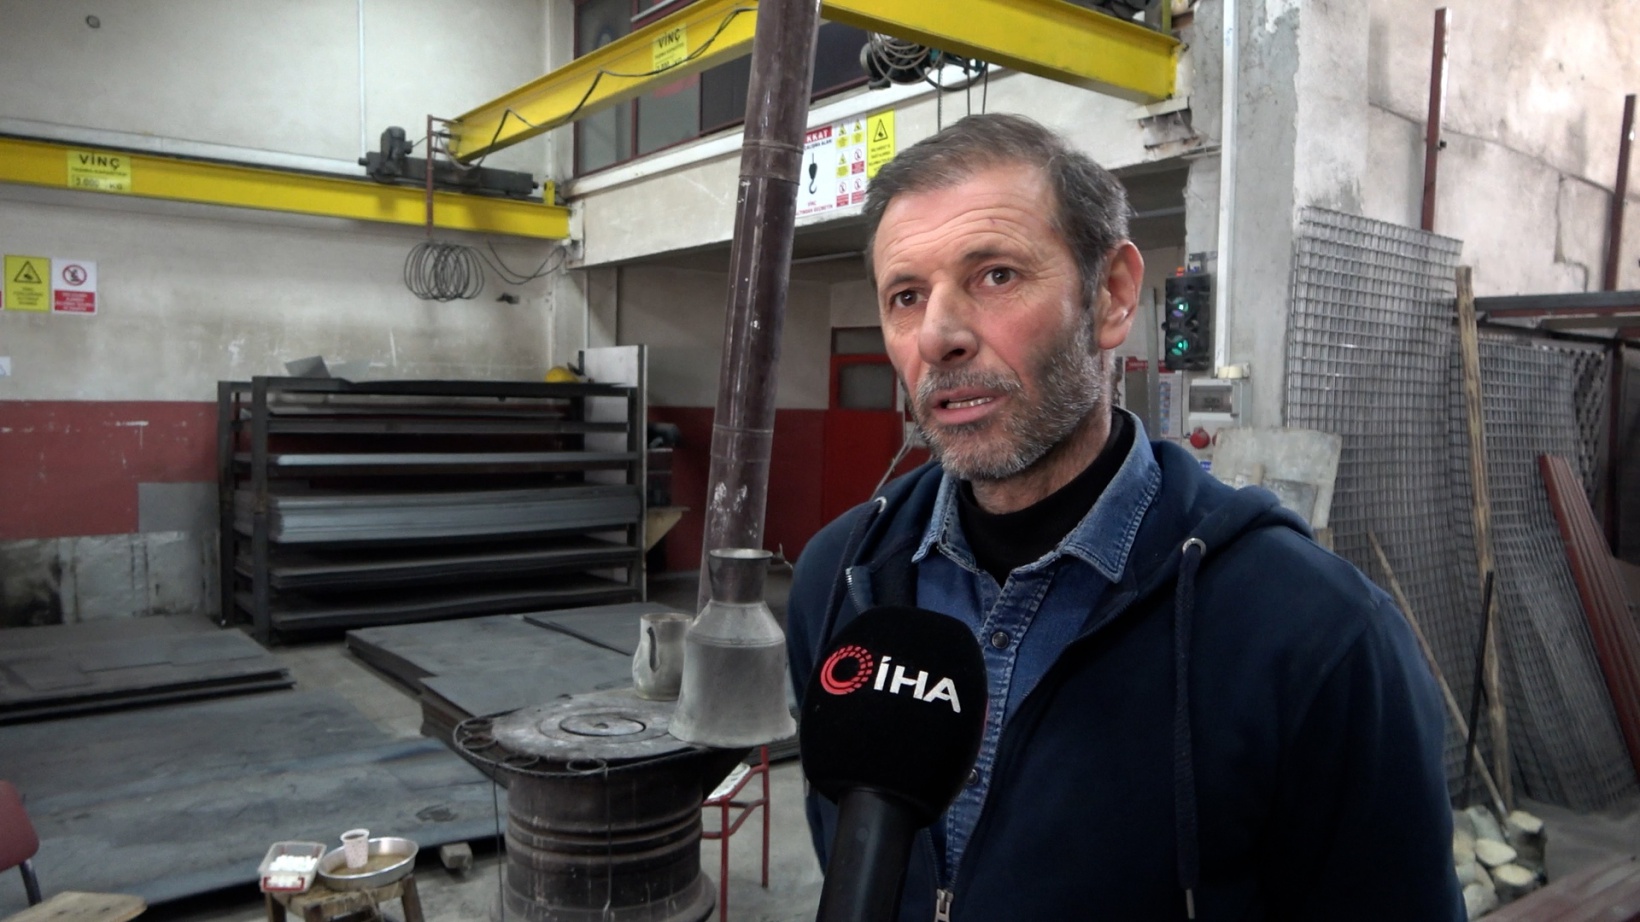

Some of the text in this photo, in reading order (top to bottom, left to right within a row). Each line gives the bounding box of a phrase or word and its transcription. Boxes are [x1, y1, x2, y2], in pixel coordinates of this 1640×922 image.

[658, 28, 680, 48] VİNÇ
[806, 130, 828, 143] KKAT
[79, 151, 120, 171] VİNÇ
[873, 655, 962, 714] İHA
